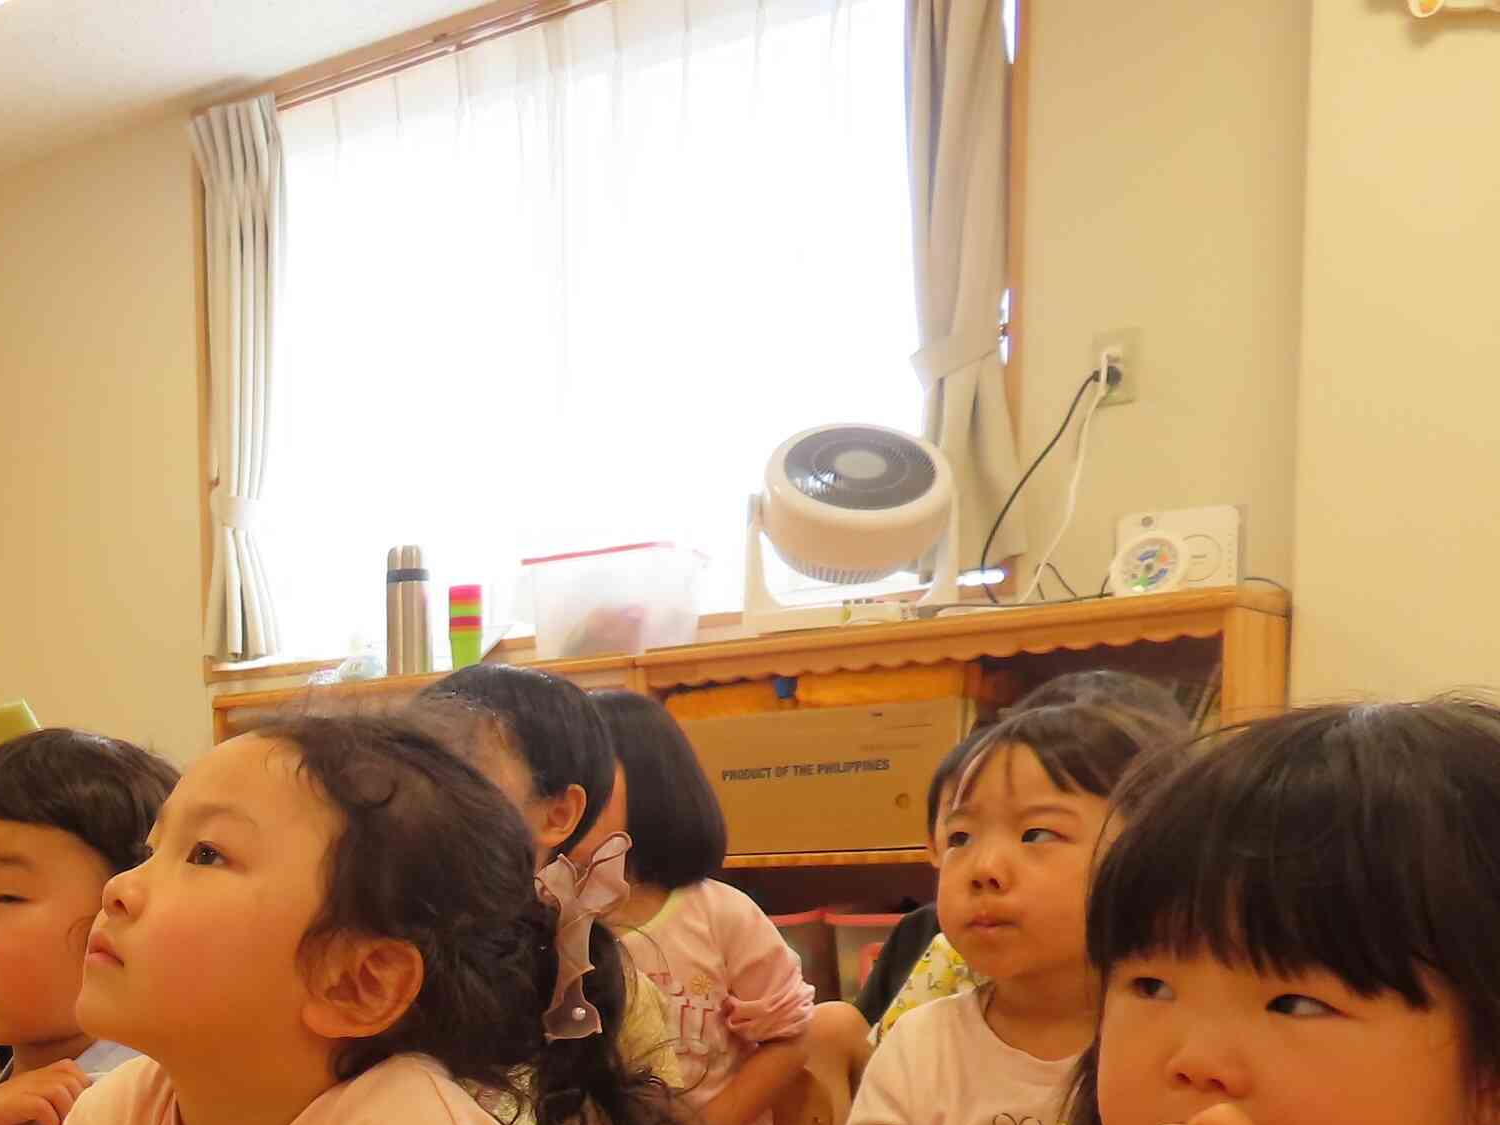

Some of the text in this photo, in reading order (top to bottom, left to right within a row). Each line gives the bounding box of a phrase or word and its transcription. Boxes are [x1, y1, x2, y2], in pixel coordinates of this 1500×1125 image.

[722, 759, 891, 782] PRODUCT OF THE PHILIPPINES
